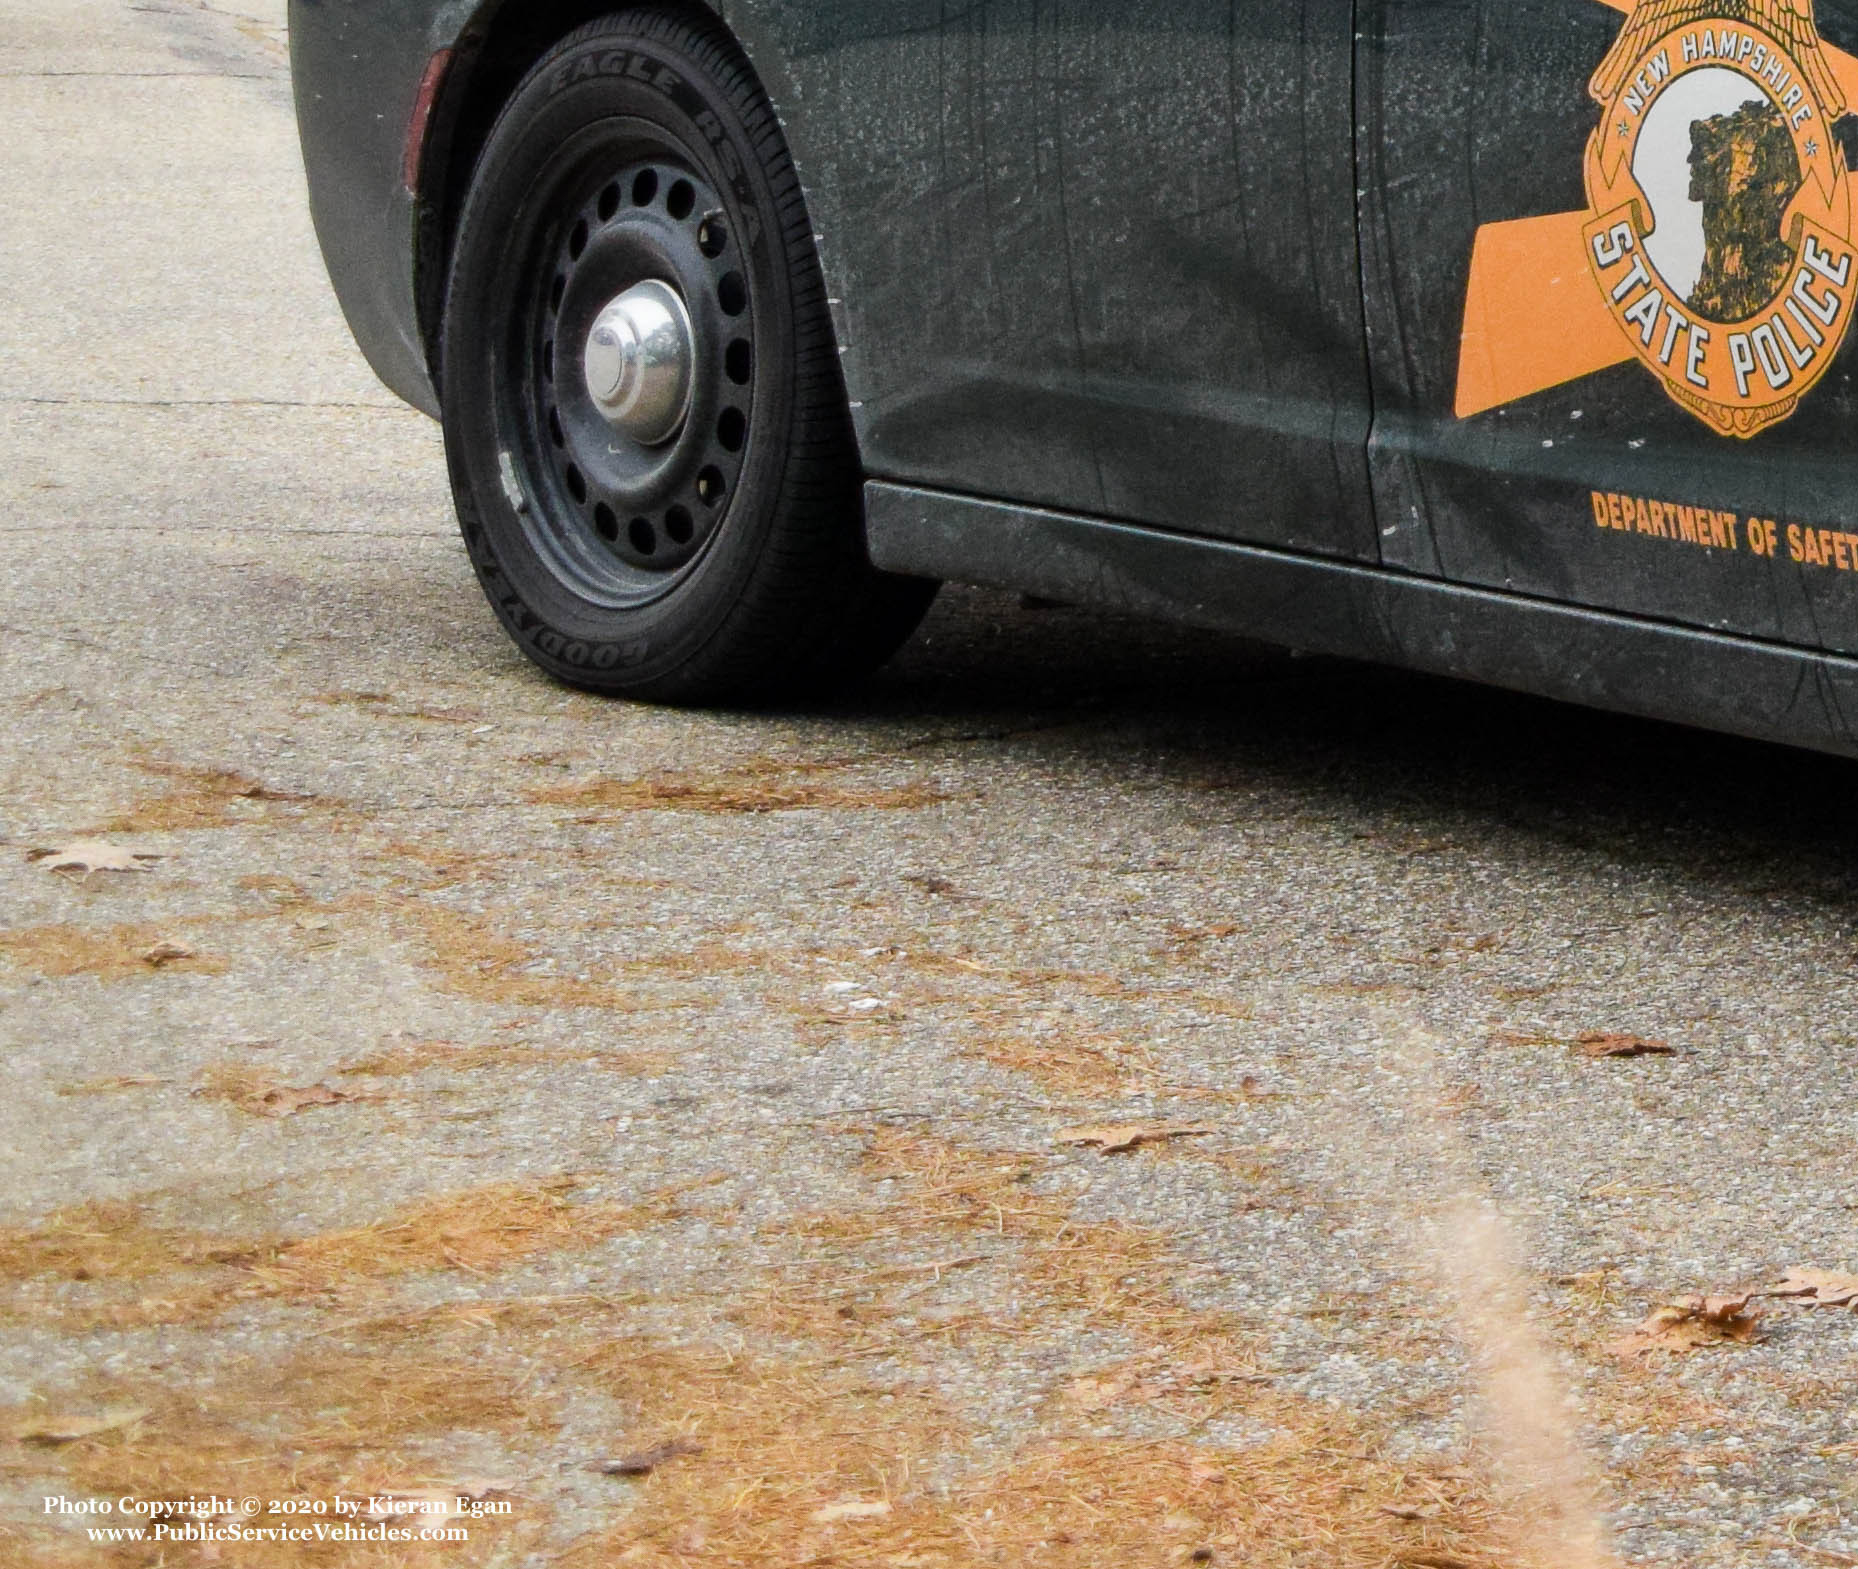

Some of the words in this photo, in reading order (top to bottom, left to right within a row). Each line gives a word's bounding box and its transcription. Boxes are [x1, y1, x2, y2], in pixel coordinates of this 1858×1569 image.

[1623, 49, 1671, 116] NEW
[1681, 29, 1812, 131] HAMPSHIRE
[1592, 221, 1709, 389] STATE
[1728, 234, 1852, 397] POLICE
[1591, 491, 1738, 550] DEPARTMENT
[1747, 517, 1778, 558] OF
